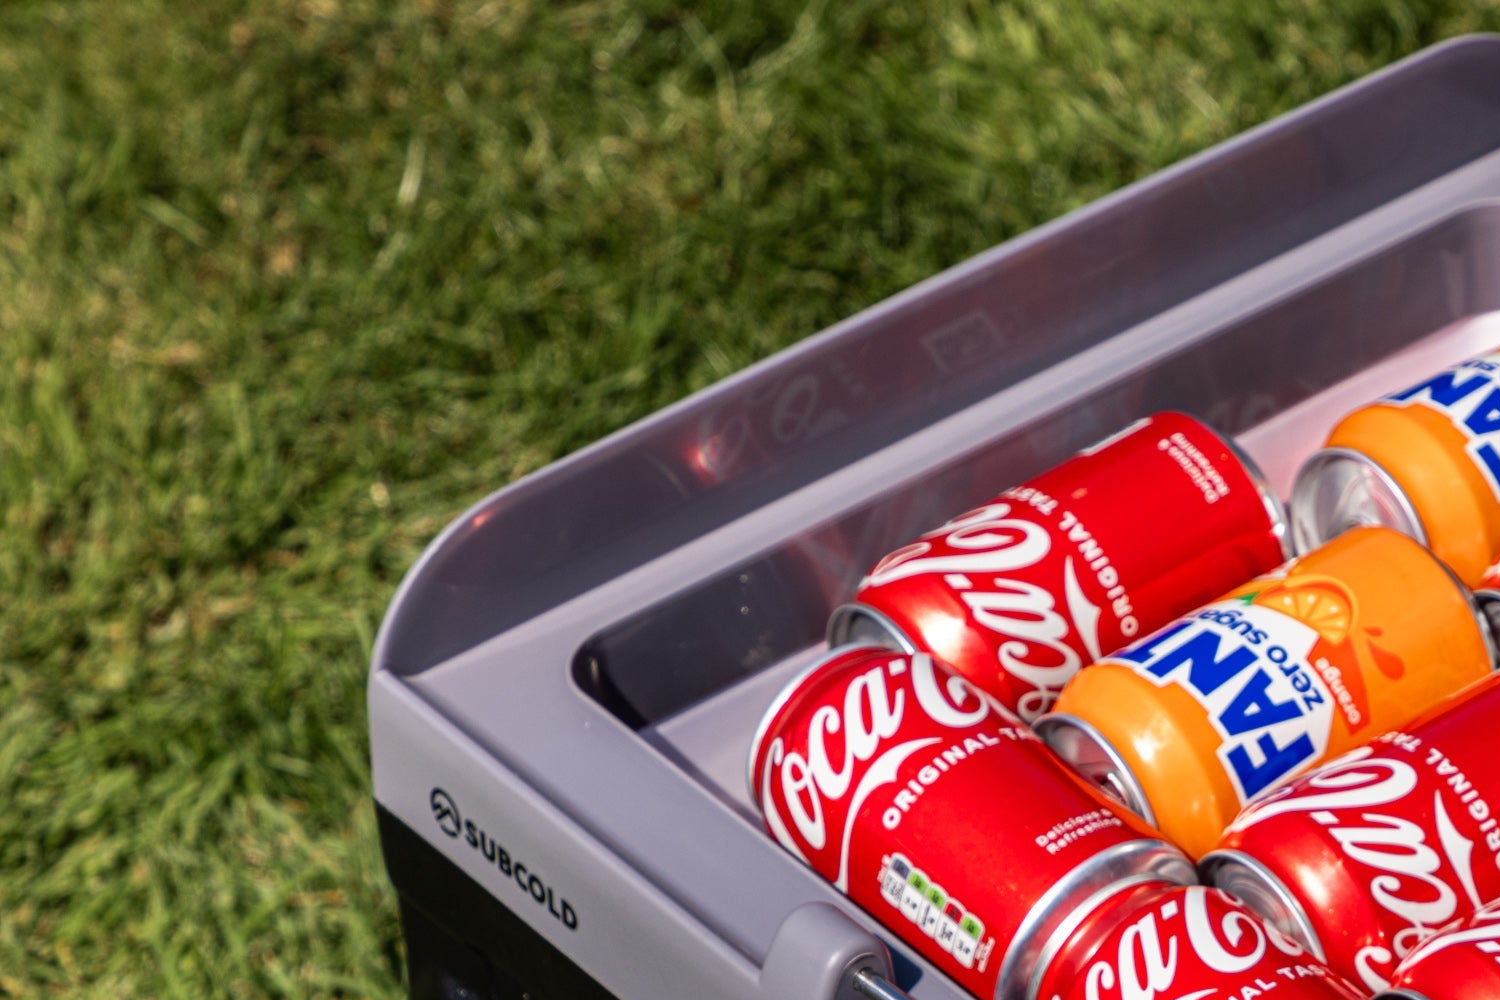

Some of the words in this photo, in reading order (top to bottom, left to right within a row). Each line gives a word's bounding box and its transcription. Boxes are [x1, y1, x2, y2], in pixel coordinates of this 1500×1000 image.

[1169, 432, 1231, 497] Refreshing
[1058, 511, 1139, 637] ORIGINAL
[1266, 643, 1325, 713] zero
[1314, 657, 1362, 726] orange
[882, 732, 1000, 829] ORIGINAL
[1034, 811, 1100, 848] Delicious
[1045, 816, 1123, 855] Refreshing
[464, 819, 578, 931] SUBCOLD
